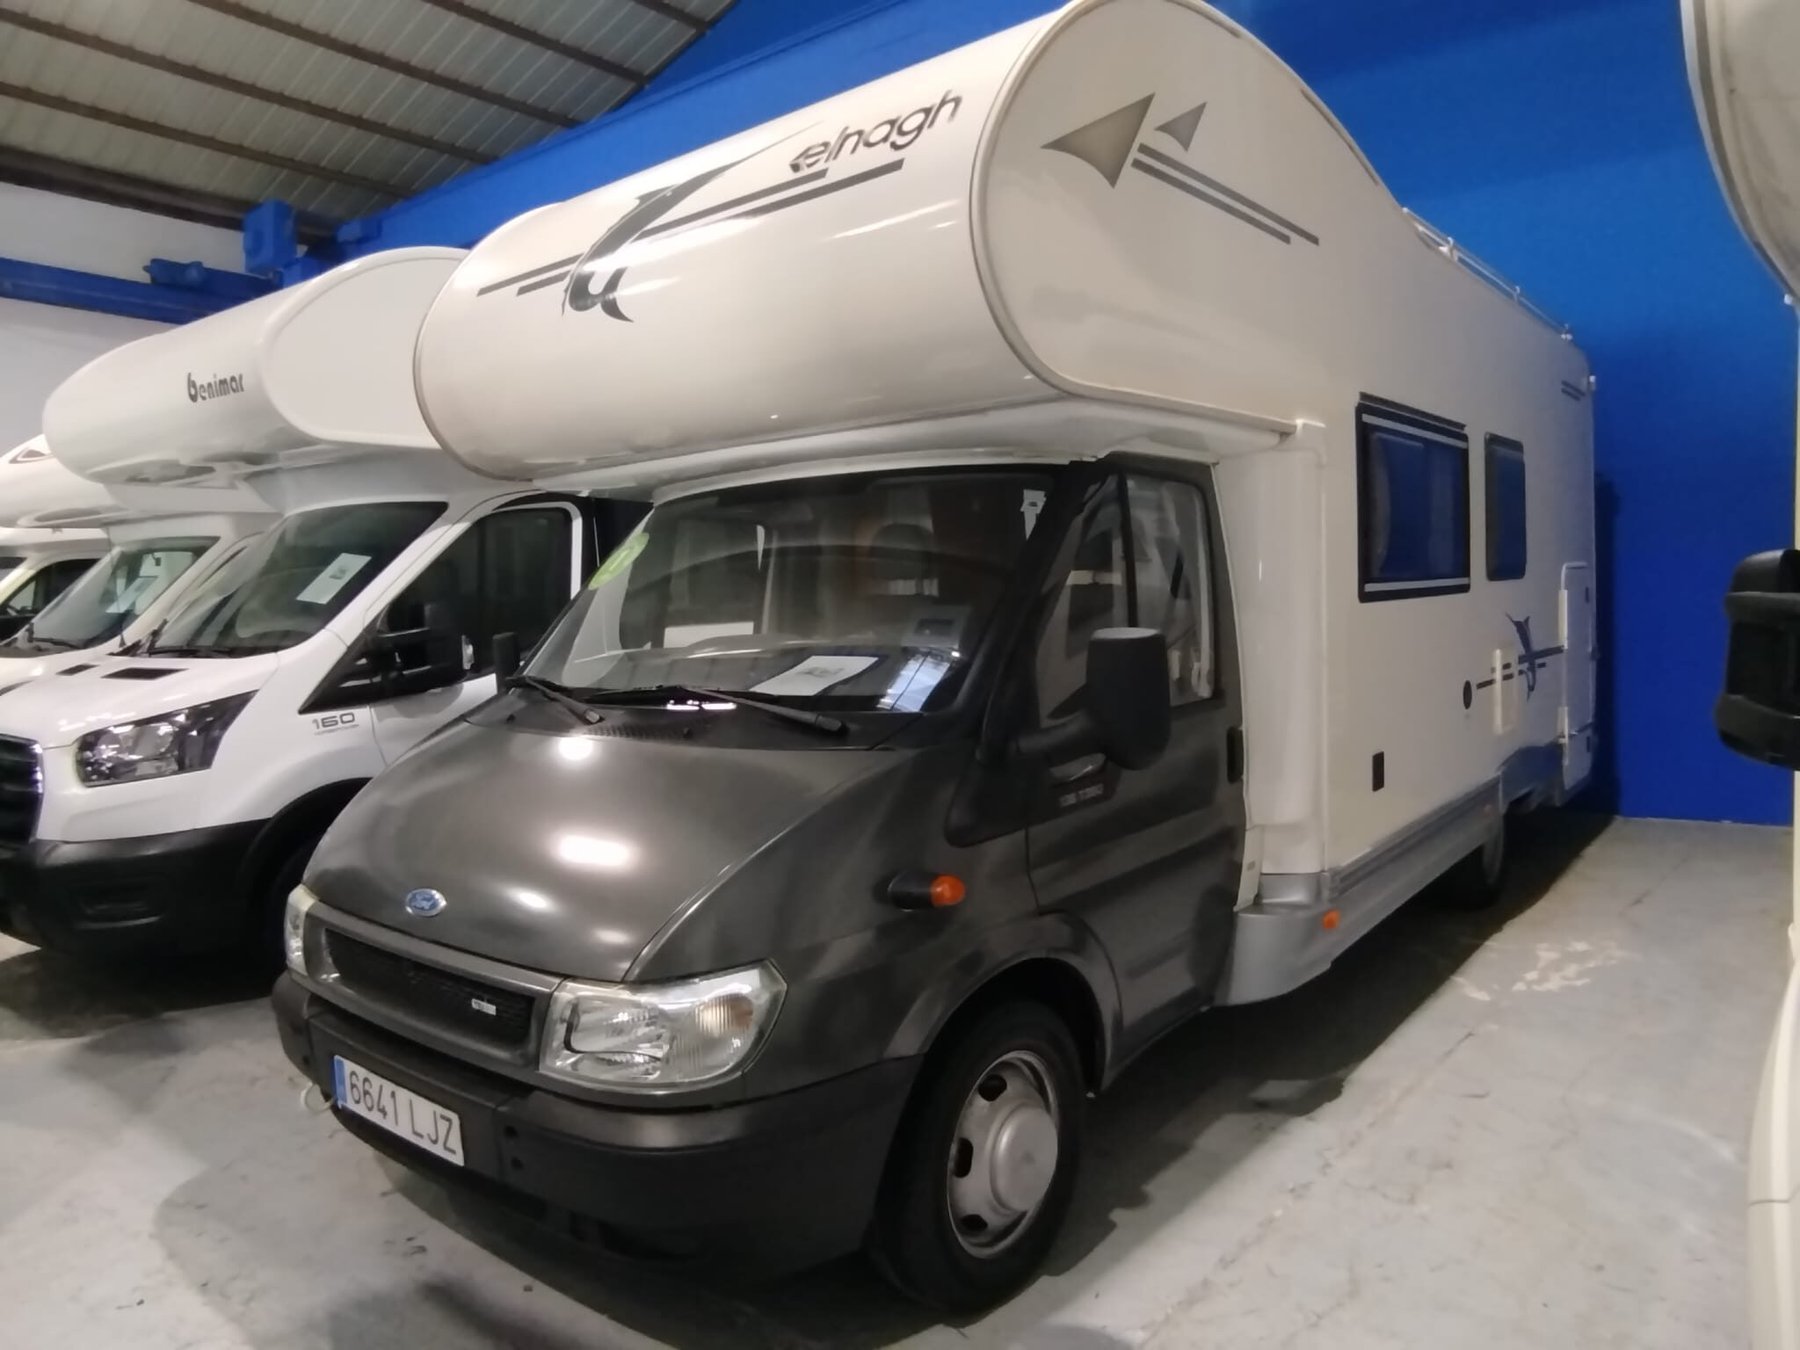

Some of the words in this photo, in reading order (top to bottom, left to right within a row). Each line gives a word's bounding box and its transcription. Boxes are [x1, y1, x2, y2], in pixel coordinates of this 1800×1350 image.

[790, 89, 962, 173] elnagh
[187, 372, 244, 403] benimar
[312, 712, 355, 729] 160
[350, 1071, 398, 1126] 6641
[410, 1099, 456, 1154] LJZ
